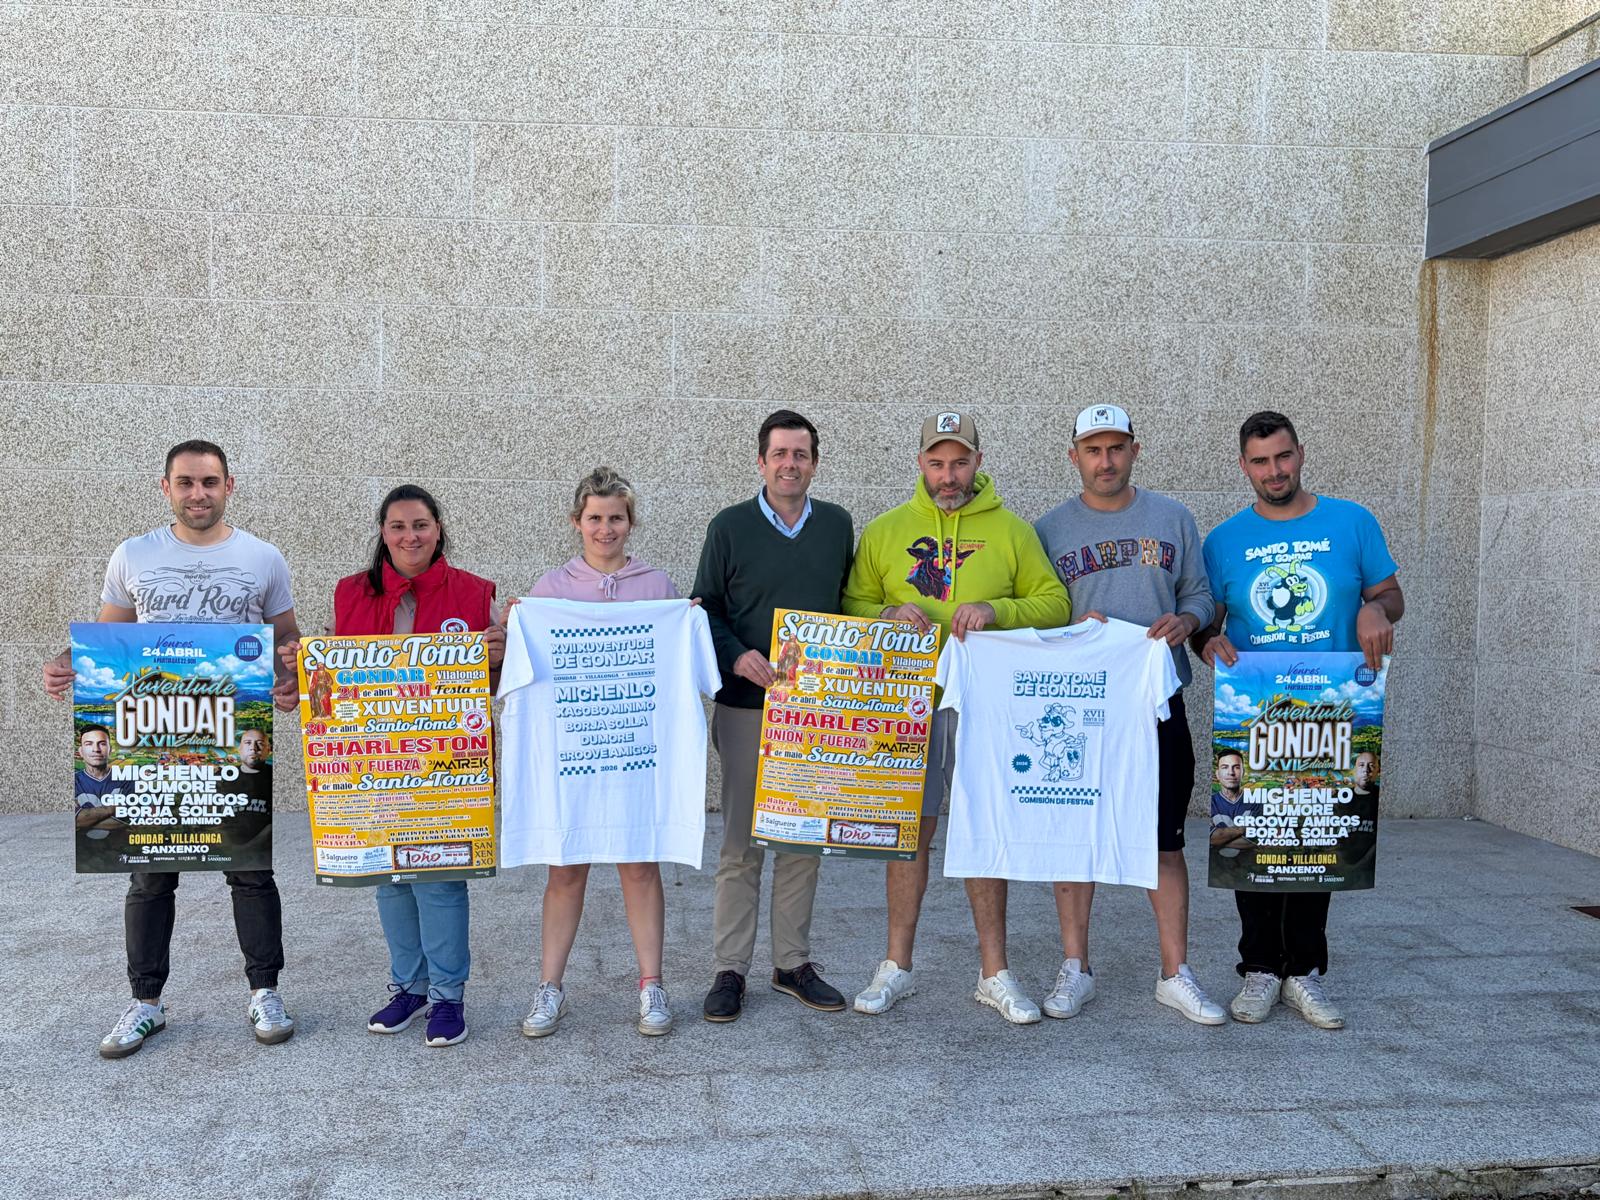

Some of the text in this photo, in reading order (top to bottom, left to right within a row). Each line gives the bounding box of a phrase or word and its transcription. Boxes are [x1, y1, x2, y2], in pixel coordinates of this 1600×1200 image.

[1245, 538, 1330, 560] SANTO TOMÉ
[1056, 537, 1176, 585] HARPER
[1262, 552, 1312, 563] DE GONDAR
[137, 584, 249, 622] Hard Rock
[435, 635, 472, 644] 2026
[778, 612, 937, 654] Santo Tomé
[1301, 630, 1330, 643] FESTAS
[155, 634, 194, 649] Venres
[551, 638, 654, 654] XVII XUVENTUDE
[142, 647, 207, 658] 24.ABRIL
[303, 634, 486, 671] Santo Tomé
[552, 651, 655, 669] DE GONDAR
[804, 645, 934, 668] GONDAR Vilalonga
[336, 667, 486, 685] GONDAR Vilalonga
[803, 660, 823, 674] 24
[836, 667, 853, 676] abril
[856, 665, 886, 680] XVII
[889, 669, 919, 681] Festa
[1288, 663, 1320, 675] Venres
[116, 669, 237, 700] Xuventude
[1013, 670, 1106, 685] SANTO TOMÉ
[1275, 675, 1331, 684] 24.ABRIL
[337, 685, 360, 700] 24
[363, 689, 371, 697] de
[374, 688, 393, 697] abril
[396, 684, 432, 698] XVII
[435, 685, 471, 694] Festa
[554, 681, 656, 703] MICHENLO
[823, 677, 932, 699] XUVENTUDE
[1013, 684, 1106, 698] DE GONDAR
[362, 697, 487, 717] XUVENTUDE
[768, 688, 789, 704] 30
[790, 694, 798, 702] de
[799, 695, 817, 705] abril
[822, 695, 866, 711] Santo
[865, 698, 904, 713] Tomé
[556, 701, 656, 718] XACOBO MINIMO
[1250, 697, 1354, 728] Xuventude
[116, 696, 235, 747] GONDAR
[305, 715, 458, 736] 30 de abril Santo Tomé
[564, 716, 648, 732] BORJA SOLLA
[766, 707, 928, 736] CHARLESTON
[137, 734, 217, 747] XVII Edición
[307, 735, 488, 757] CHARLESTON
[581, 732, 635, 746] DUMORE
[764, 727, 926, 753] UNIÓN Y FUERZA MATREK
[1250, 721, 1351, 771] GONDAR
[558, 744, 657, 761] GROOVE AMIGOS
[762, 743, 772, 758] 1
[784, 750, 803, 759] maio
[806, 747, 868, 766] Santo
[872, 751, 925, 769] Tomé
[309, 757, 489, 774] UNIÓN Y FUERZA MATREK
[1268, 758, 1335, 771] XVII Edición
[111, 765, 239, 782] MICHENLO
[310, 777, 319, 792] 1
[333, 782, 352, 790] maio
[357, 773, 424, 791] Santo
[427, 768, 489, 787] Tomé
[134, 781, 216, 793] DUMORE
[101, 793, 248, 806] GROOVE AMIGOS
[1019, 796, 1055, 804] COMISIÓN
[1066, 798, 1094, 806] FESTAS
[1243, 787, 1353, 804] MICHENLO
[116, 806, 235, 818] BORJA SOLLA
[1263, 804, 1333, 816] DUMORE
[129, 817, 221, 826] XACOBO MINIMO
[766, 817, 797, 828] Salgueiro
[1234, 815, 1360, 827] GROOVE AMIGOS
[129, 833, 222, 845] GONDAR VILLALONGA
[1246, 827, 1348, 838] BORJA SOLLA
[142, 845, 210, 854] SANXENXO
[475, 841, 493, 849] SAN
[1257, 838, 1337, 847] XACOBO MINIMO
[326, 854, 359, 863] Salgueiro
[1256, 854, 1337, 865] GONDAR VILLALONGA
[1267, 865, 1326, 874] SANXENXO
